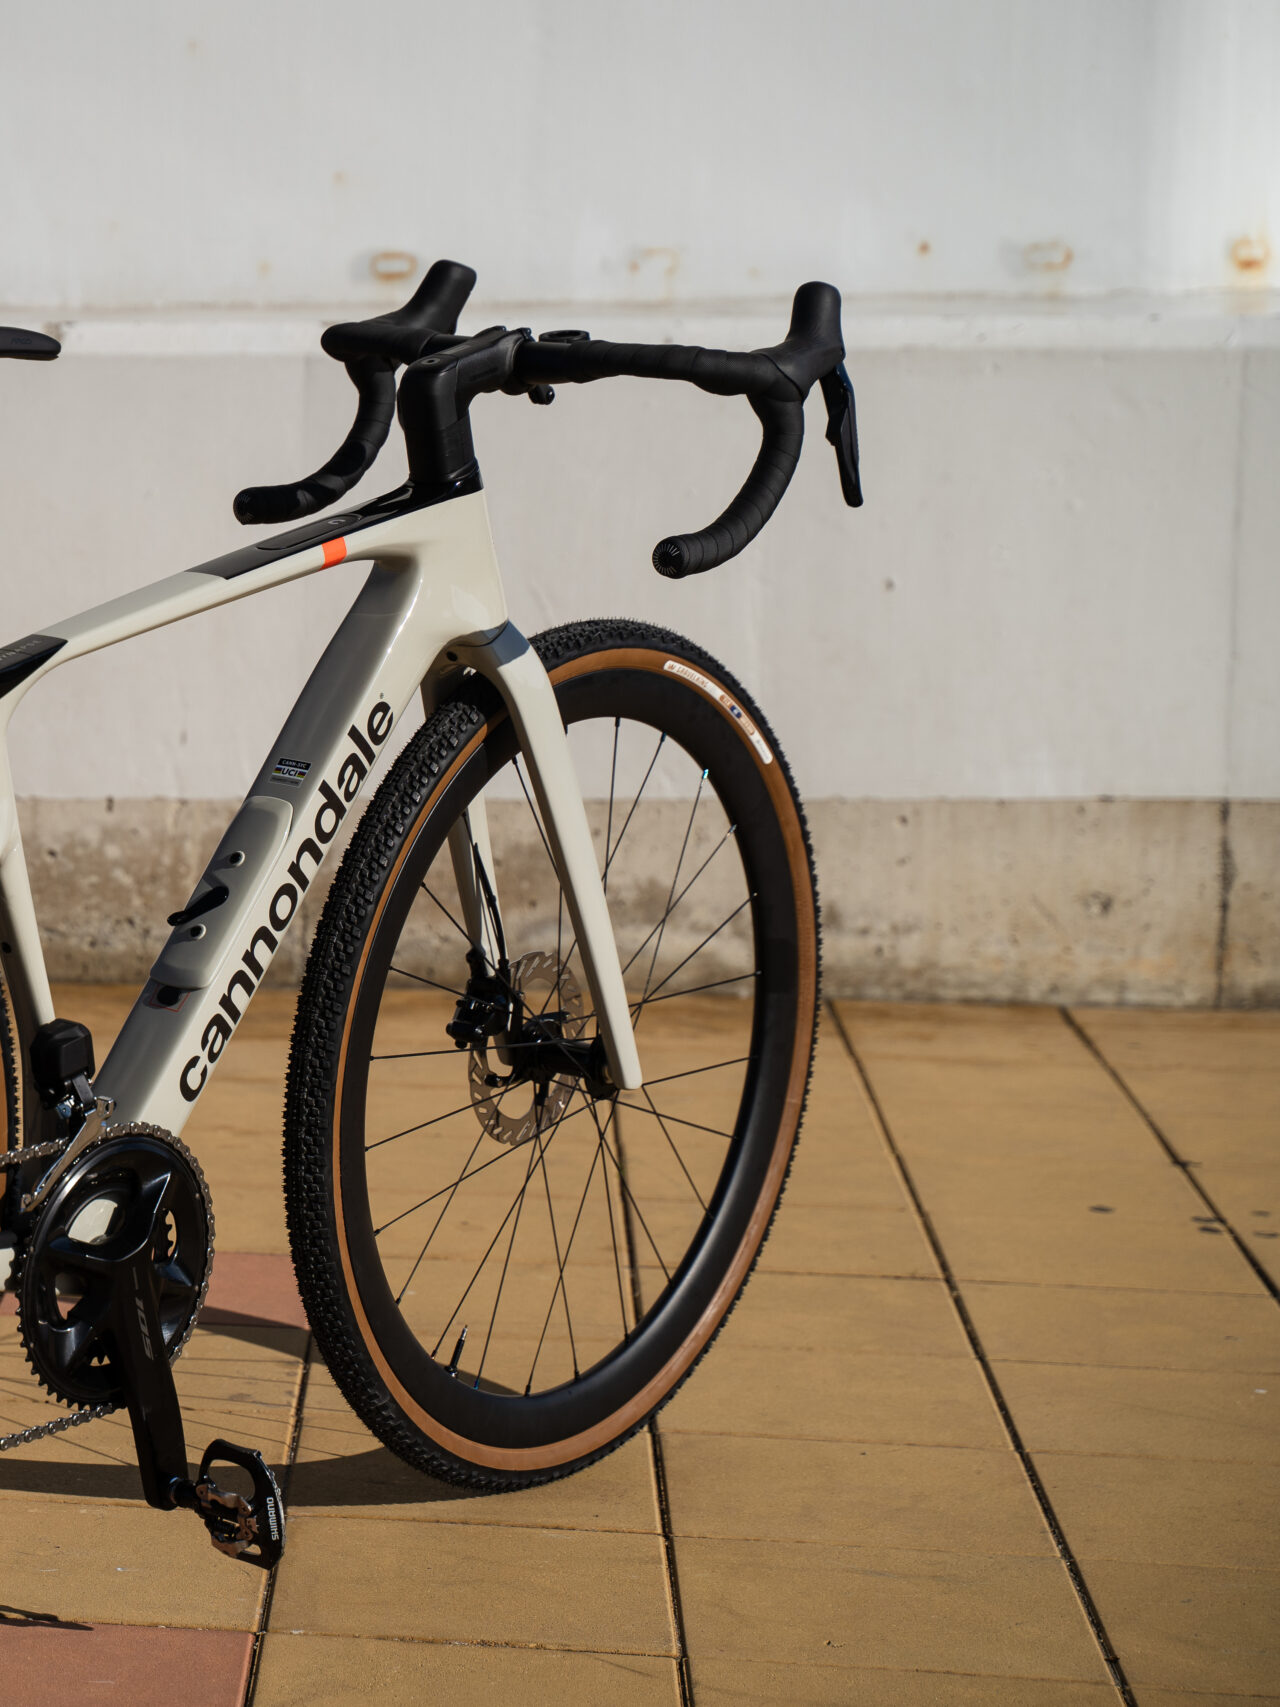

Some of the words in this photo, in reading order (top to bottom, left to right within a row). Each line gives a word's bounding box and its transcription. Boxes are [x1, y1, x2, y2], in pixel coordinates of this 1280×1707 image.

[281, 767, 299, 777] UCI
[179, 701, 393, 1102] cannondale
[135, 1296, 154, 1361] 105
[266, 1496, 280, 1541] SHIMANO
